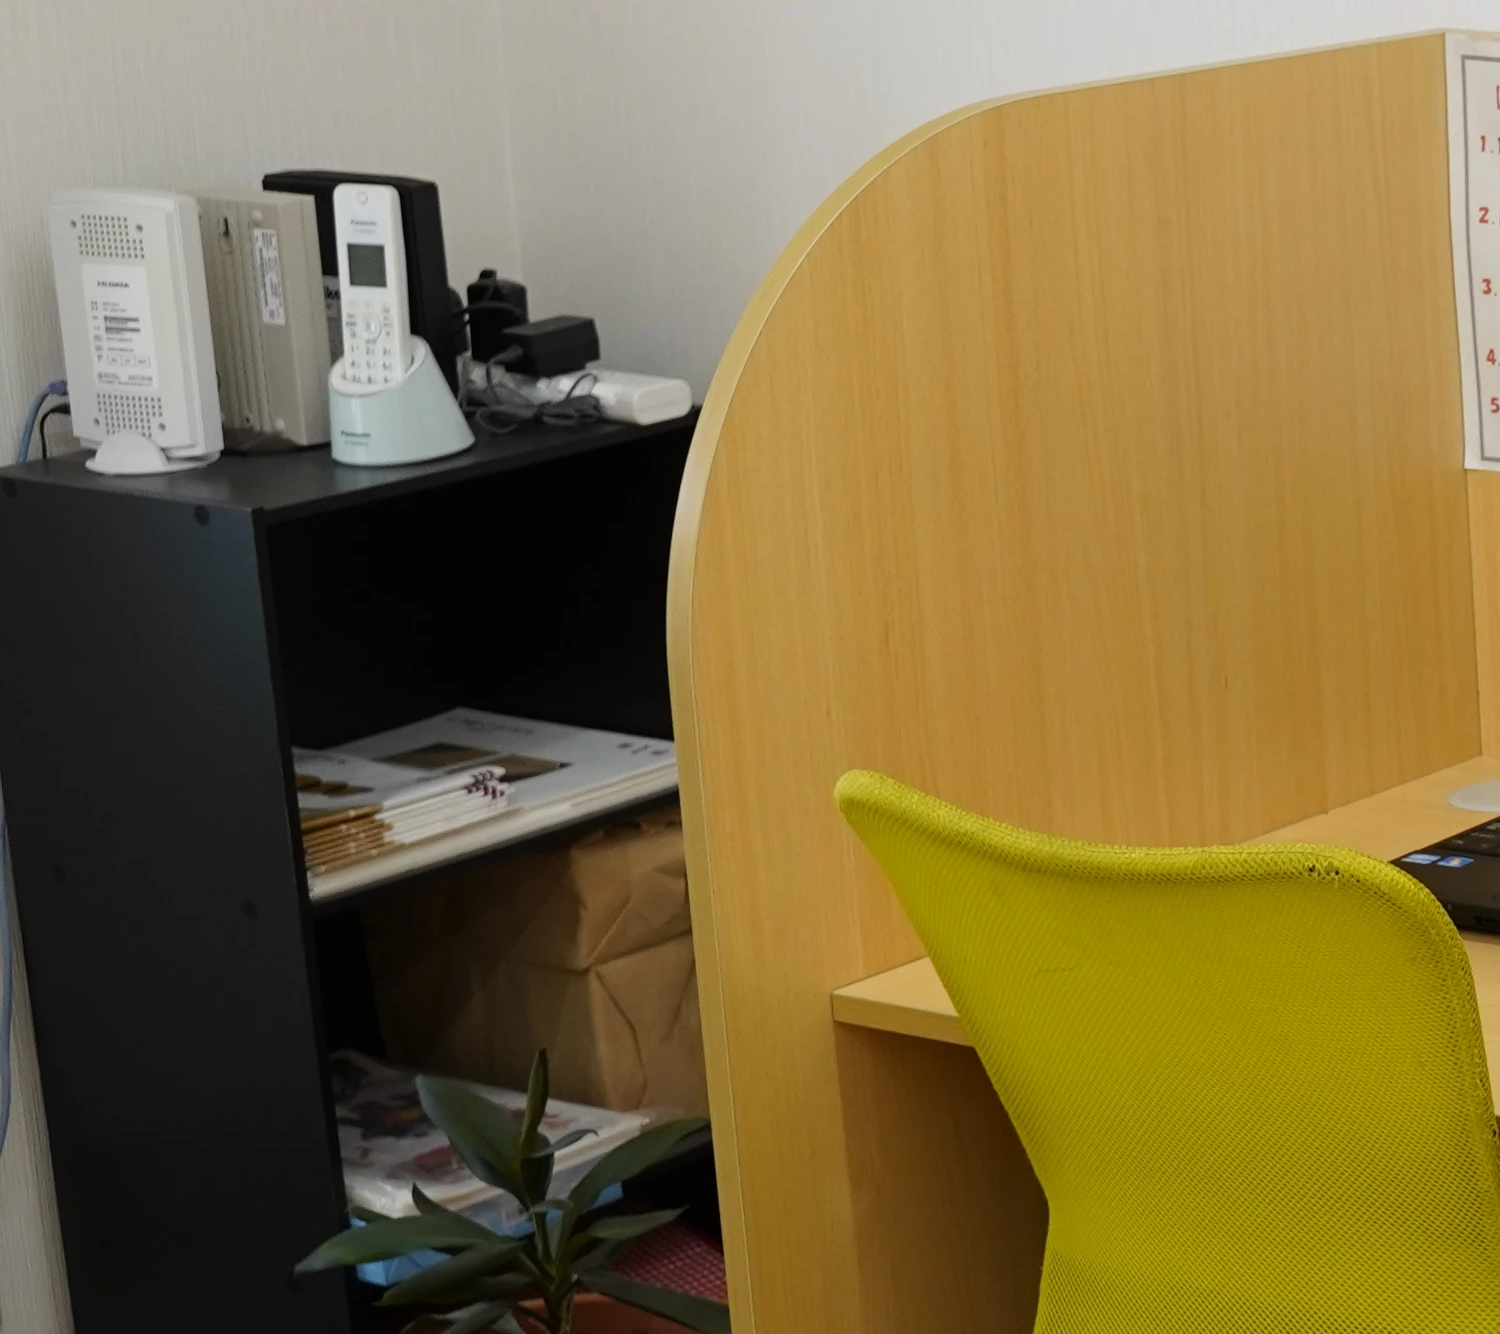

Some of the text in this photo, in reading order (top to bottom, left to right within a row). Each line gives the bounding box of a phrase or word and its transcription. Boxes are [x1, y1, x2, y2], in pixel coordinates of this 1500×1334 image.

[1480, 135, 1494, 153] 1.
[1478, 207, 1495, 225] 2.
[1481, 278, 1497, 297] 3.
[1486, 349, 1500, 367] 4.
